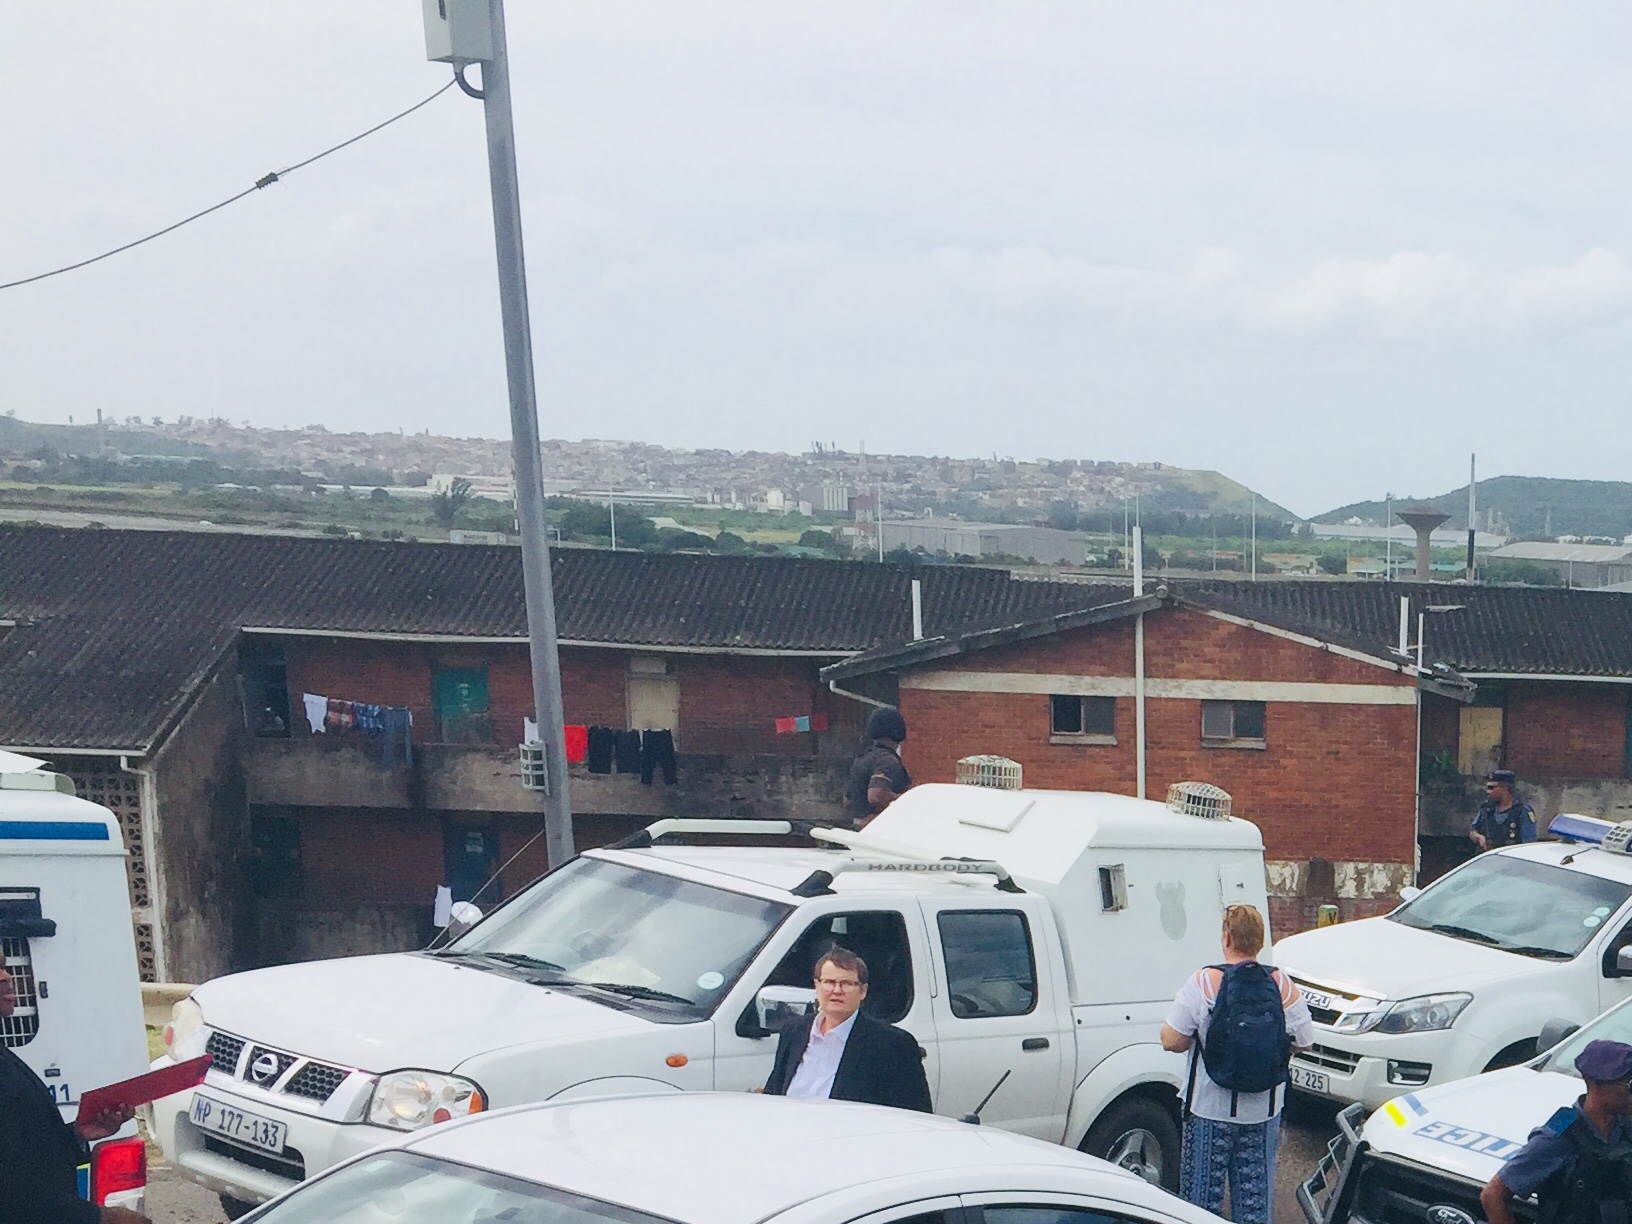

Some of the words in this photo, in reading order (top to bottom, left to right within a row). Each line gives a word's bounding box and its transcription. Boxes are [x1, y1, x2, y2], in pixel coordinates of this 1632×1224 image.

[867, 863, 982, 872] HARDBODY
[193, 1099, 212, 1124] NP
[218, 1107, 280, 1148] 177-133
